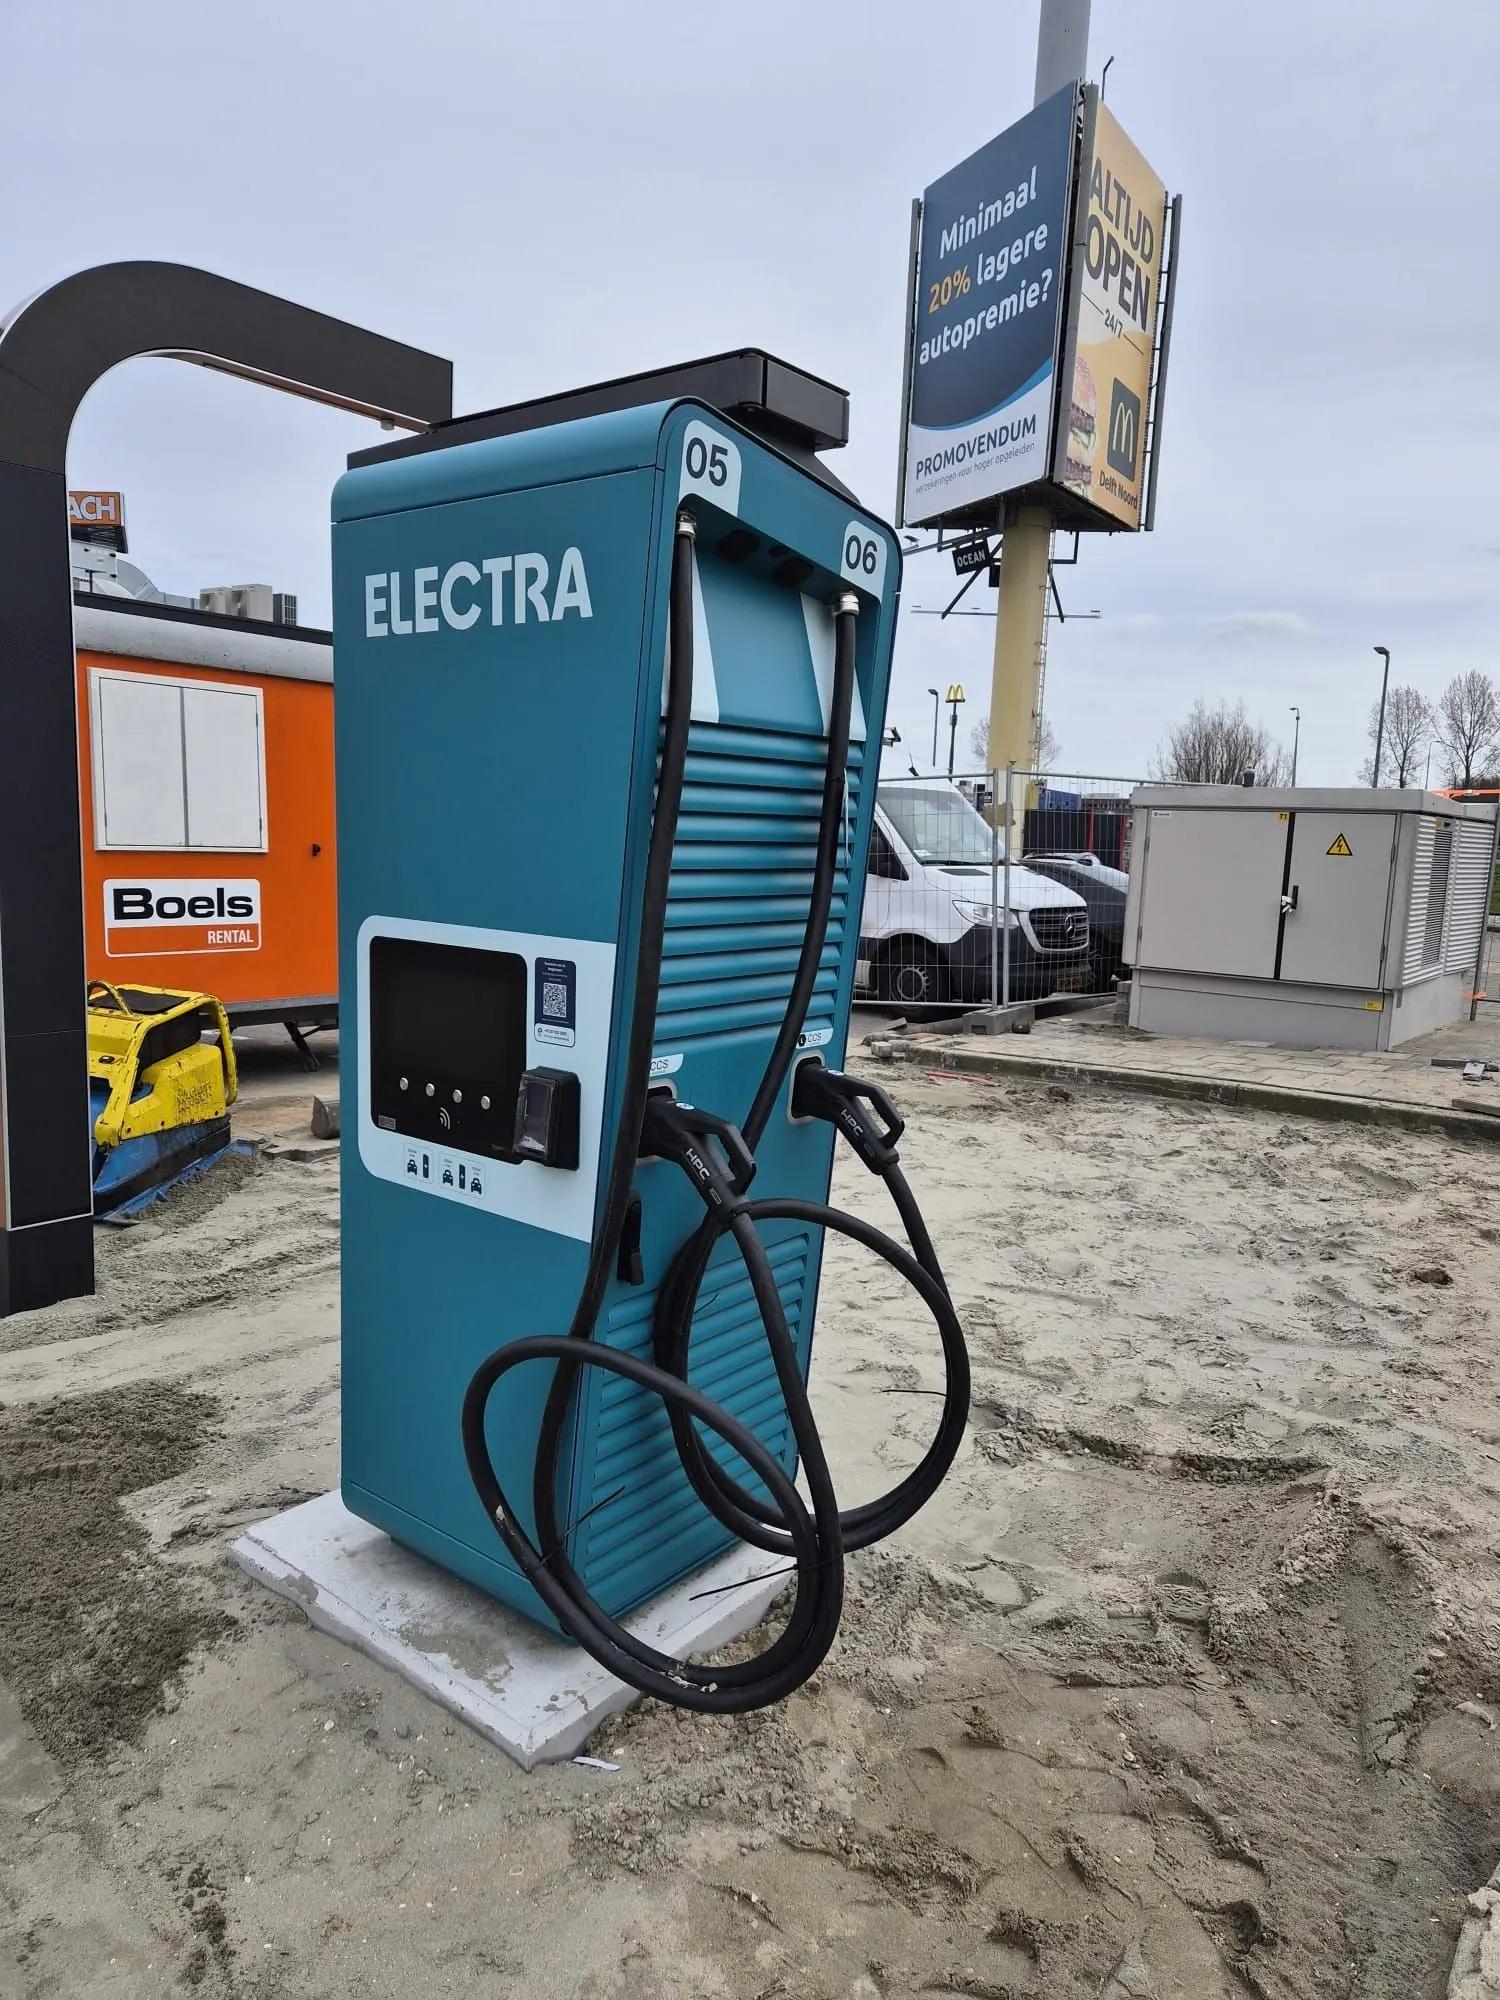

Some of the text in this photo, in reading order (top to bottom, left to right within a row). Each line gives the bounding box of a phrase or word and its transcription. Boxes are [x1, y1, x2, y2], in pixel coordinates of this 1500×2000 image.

[939, 165, 1038, 260] Minimaal
[1090, 157, 1154, 264] ALTIJD
[928, 223, 1048, 314] 20% lagere
[1085, 213, 1151, 332] OPEN
[919, 268, 1053, 365] autopremie?
[1104, 309, 1124, 339] 24/7
[685, 437, 729, 487] 05
[915, 414, 1037, 480] PROMOVENDUM
[994, 442, 1035, 465] opgeleiden
[1099, 470, 1138, 509] Delft Noord
[845, 534, 878, 575] 06
[956, 549, 986, 567] OCEAN
[365, 546, 594, 638] ELECTRA
[113, 887, 254, 921] Boels
[207, 929, 254, 945] RENTAL
[807, 1032, 822, 1043] CCS
[650, 1059, 668, 1071] CCS
[840, 1109, 863, 1137] HPC
[686, 1147, 710, 1180] HPC
